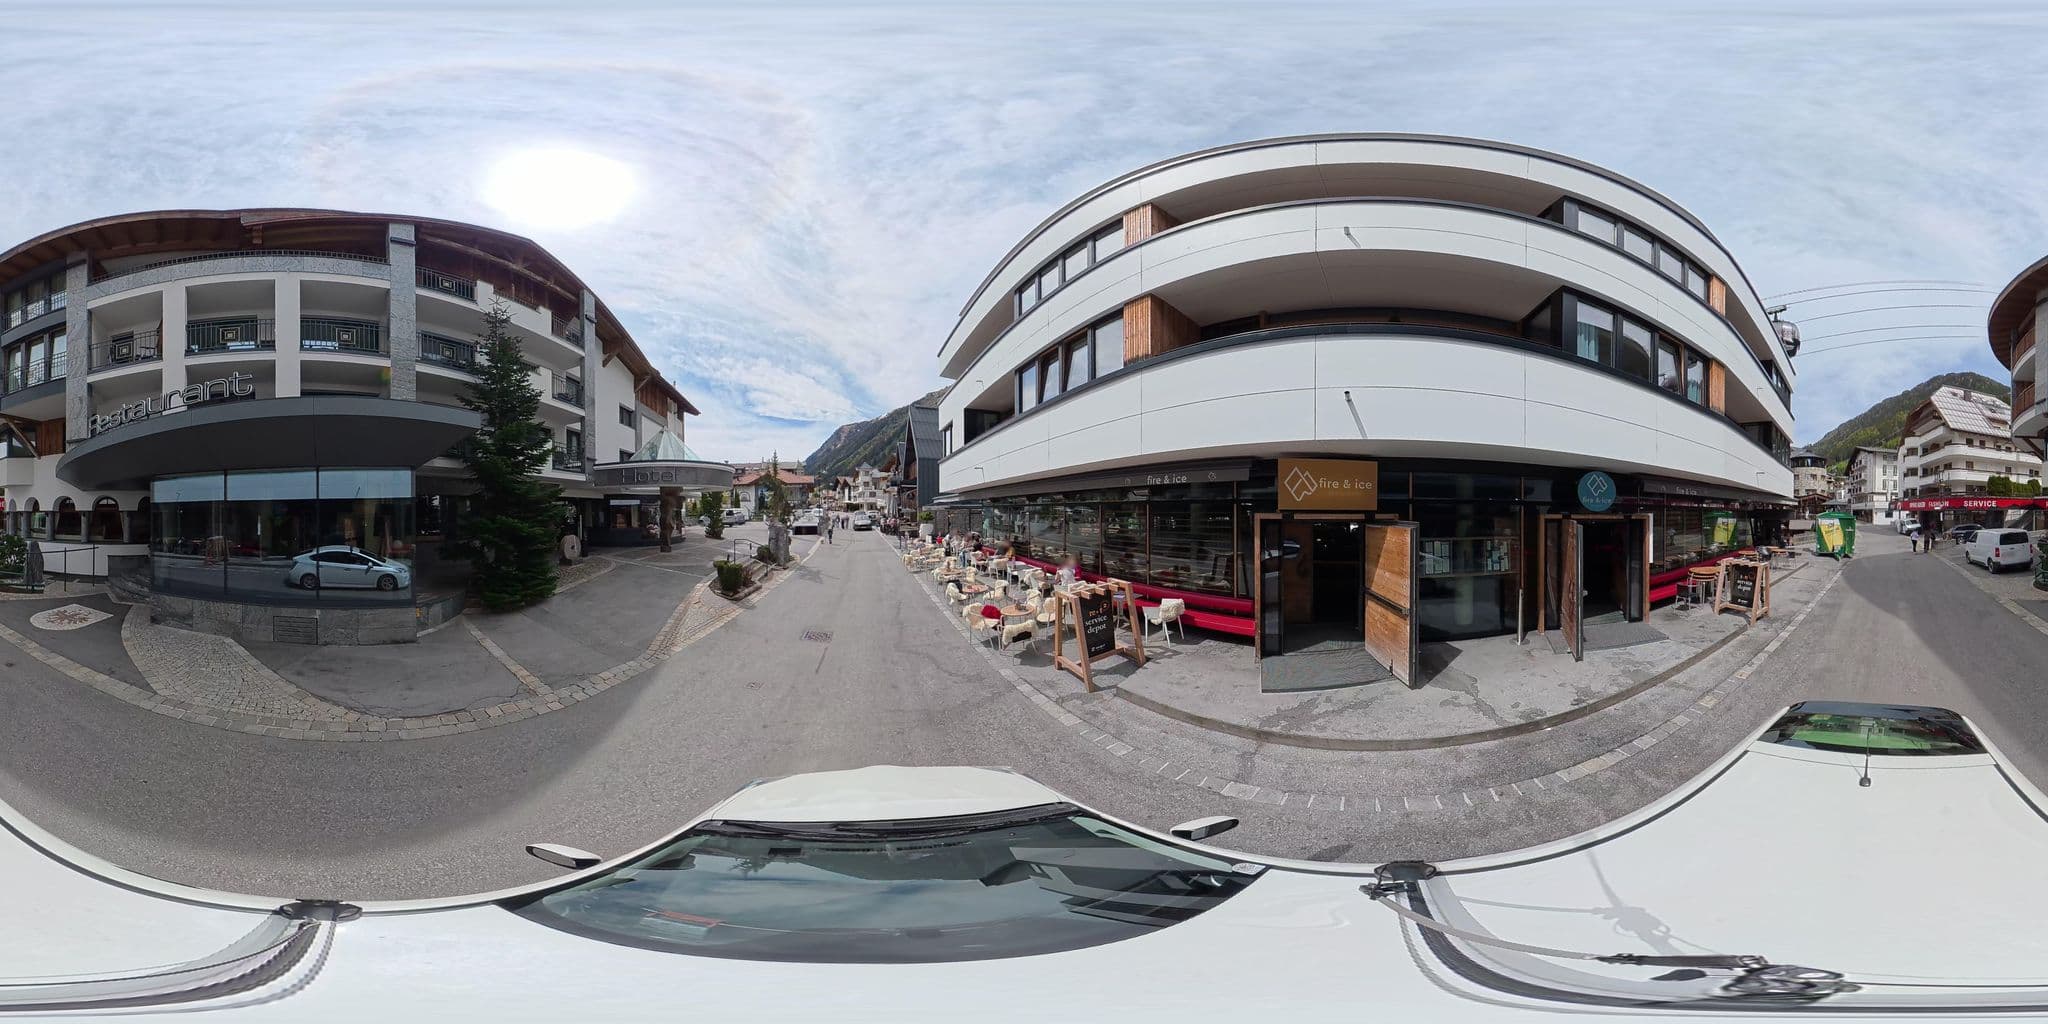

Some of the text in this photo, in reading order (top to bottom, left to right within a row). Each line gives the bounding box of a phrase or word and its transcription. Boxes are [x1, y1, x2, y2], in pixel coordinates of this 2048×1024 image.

[87, 371, 253, 438] Restaurant
[622, 466, 677, 484] Hotel
[1147, 473, 1187, 485] fire & ice
[1319, 477, 1373, 490] fire & ice
[1085, 615, 1108, 626] service
[1087, 623, 1107, 634] depot
